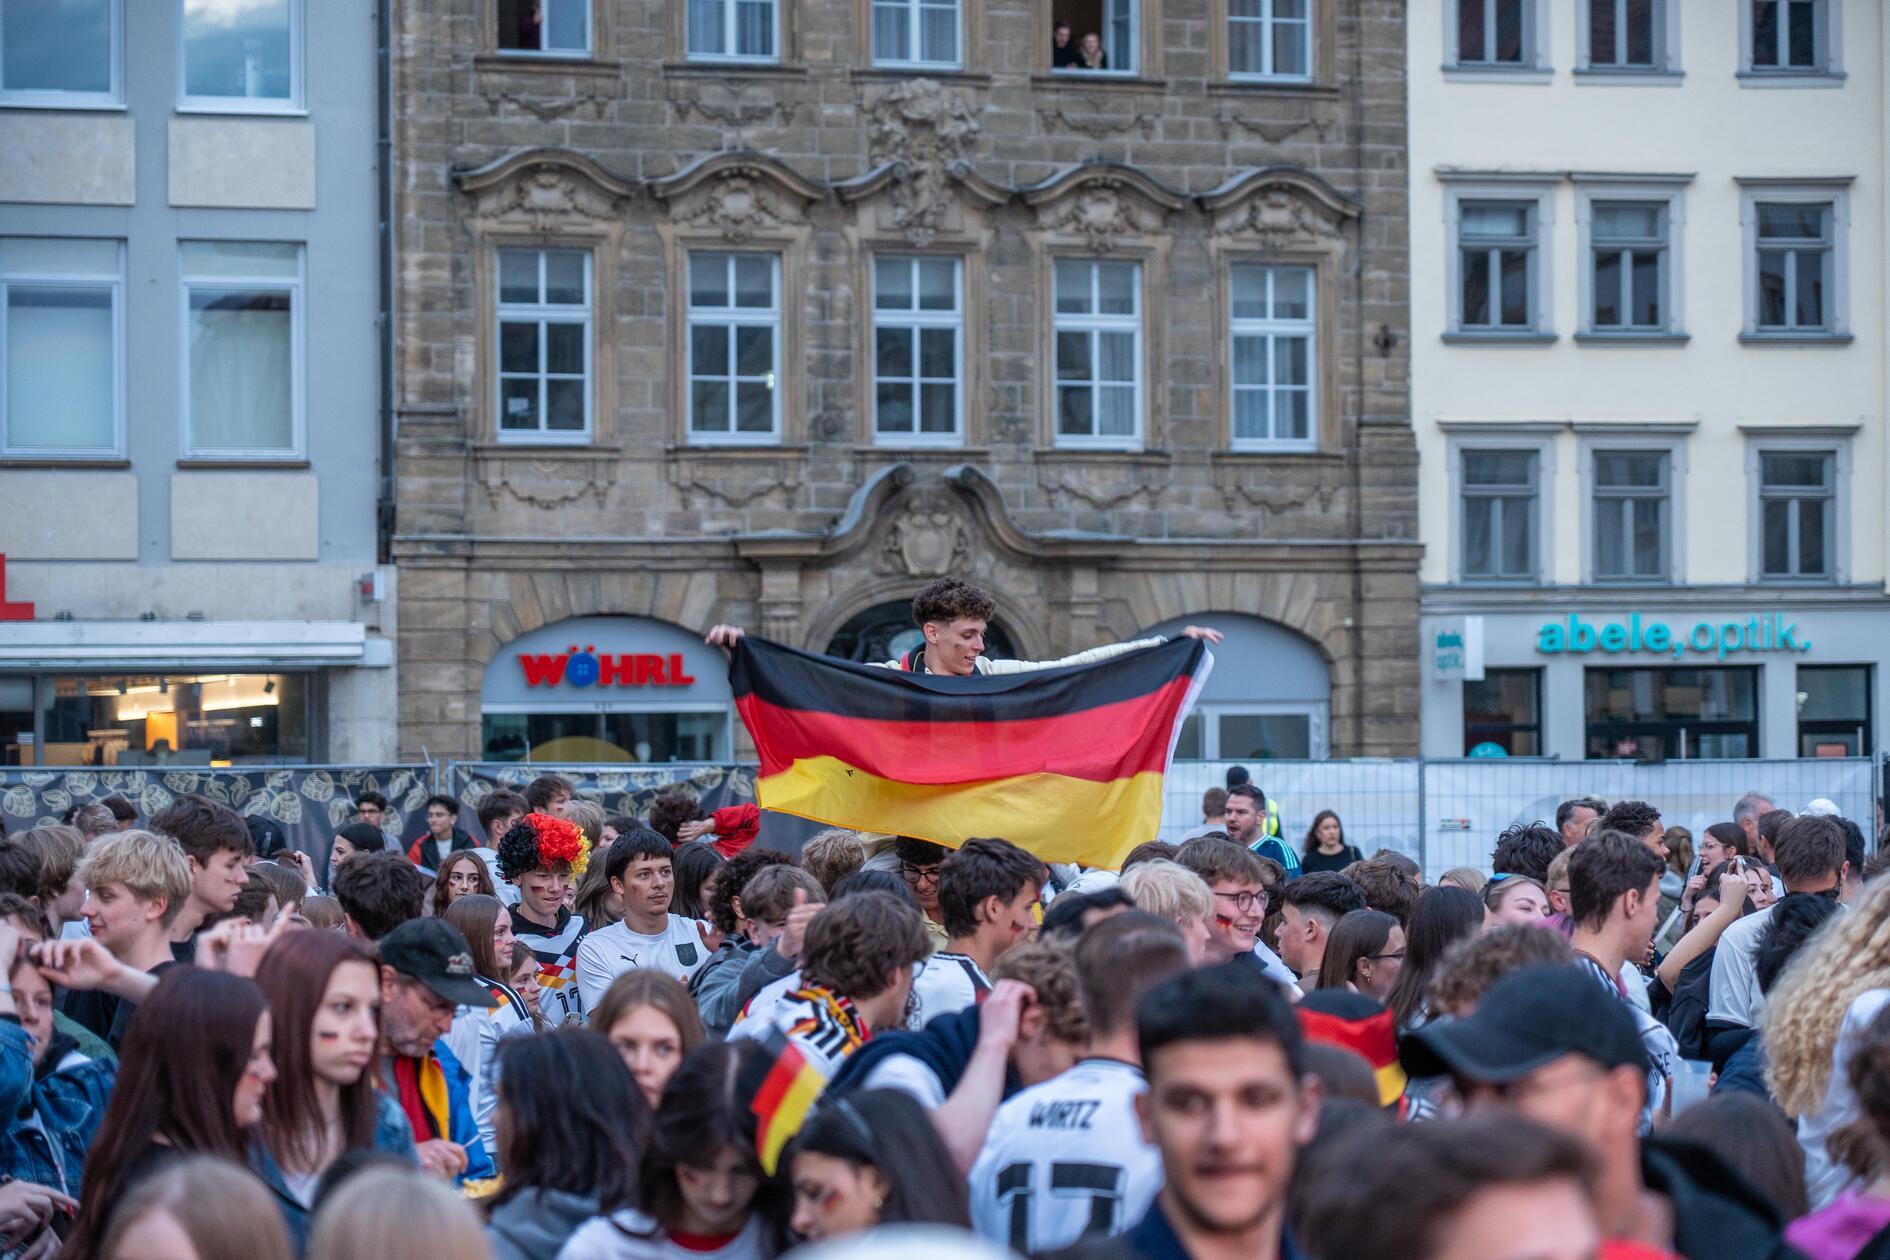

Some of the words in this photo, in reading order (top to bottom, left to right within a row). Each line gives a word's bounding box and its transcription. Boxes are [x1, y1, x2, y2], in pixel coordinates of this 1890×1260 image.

[518, 645, 696, 688] WÖHRL
[1028, 1099, 1101, 1128] WIRTZ
[997, 1160, 1125, 1254] 17
